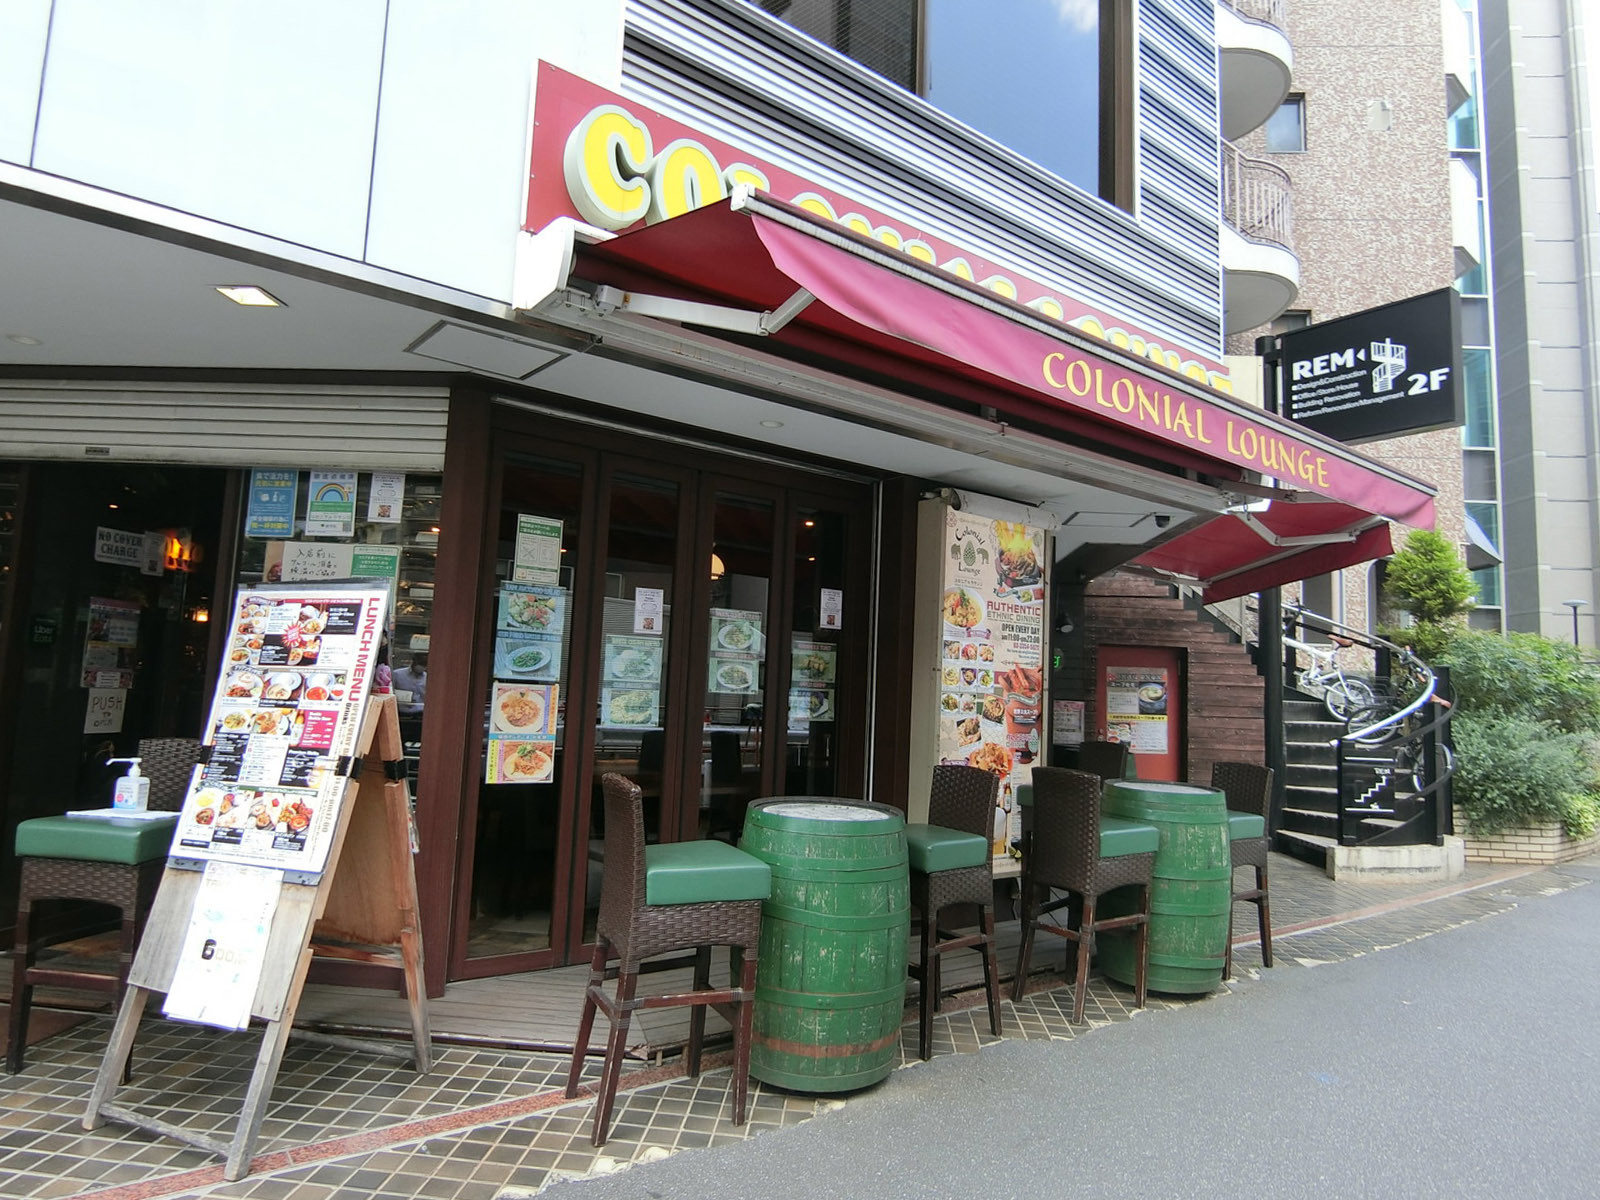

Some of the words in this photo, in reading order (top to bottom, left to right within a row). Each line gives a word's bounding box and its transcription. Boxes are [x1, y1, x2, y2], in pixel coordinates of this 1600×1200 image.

[1292, 348, 1355, 381] REM
[1406, 367, 1451, 396] 2F
[1323, 391, 1361, 404] Renovation
[1042, 351, 1212, 444] COLONIAL
[1226, 420, 1331, 488] LOUNGE
[98, 530, 112, 541] NO
[113, 532, 143, 546] COVER
[954, 526, 986, 545] Colonial
[101, 543, 139, 558] CHARGE
[297, 548, 337, 559] 入店前に
[958, 562, 981, 577] Lounge
[987, 601, 1041, 616] AUTHENTIC
[359, 597, 380, 651] LUNCH
[987, 611, 1014, 620] ETHNIC
[1016, 614, 1041, 624] DINING
[34, 625, 54, 634] Uber
[1002, 623, 1014, 632] OPEN
[1016, 625, 1030, 634] EVERY
[1031, 626, 1040, 635] DAY
[348, 654, 369, 701] MENU
[92, 696, 123, 712] PUSH
[341, 702, 352, 725] Drinks
